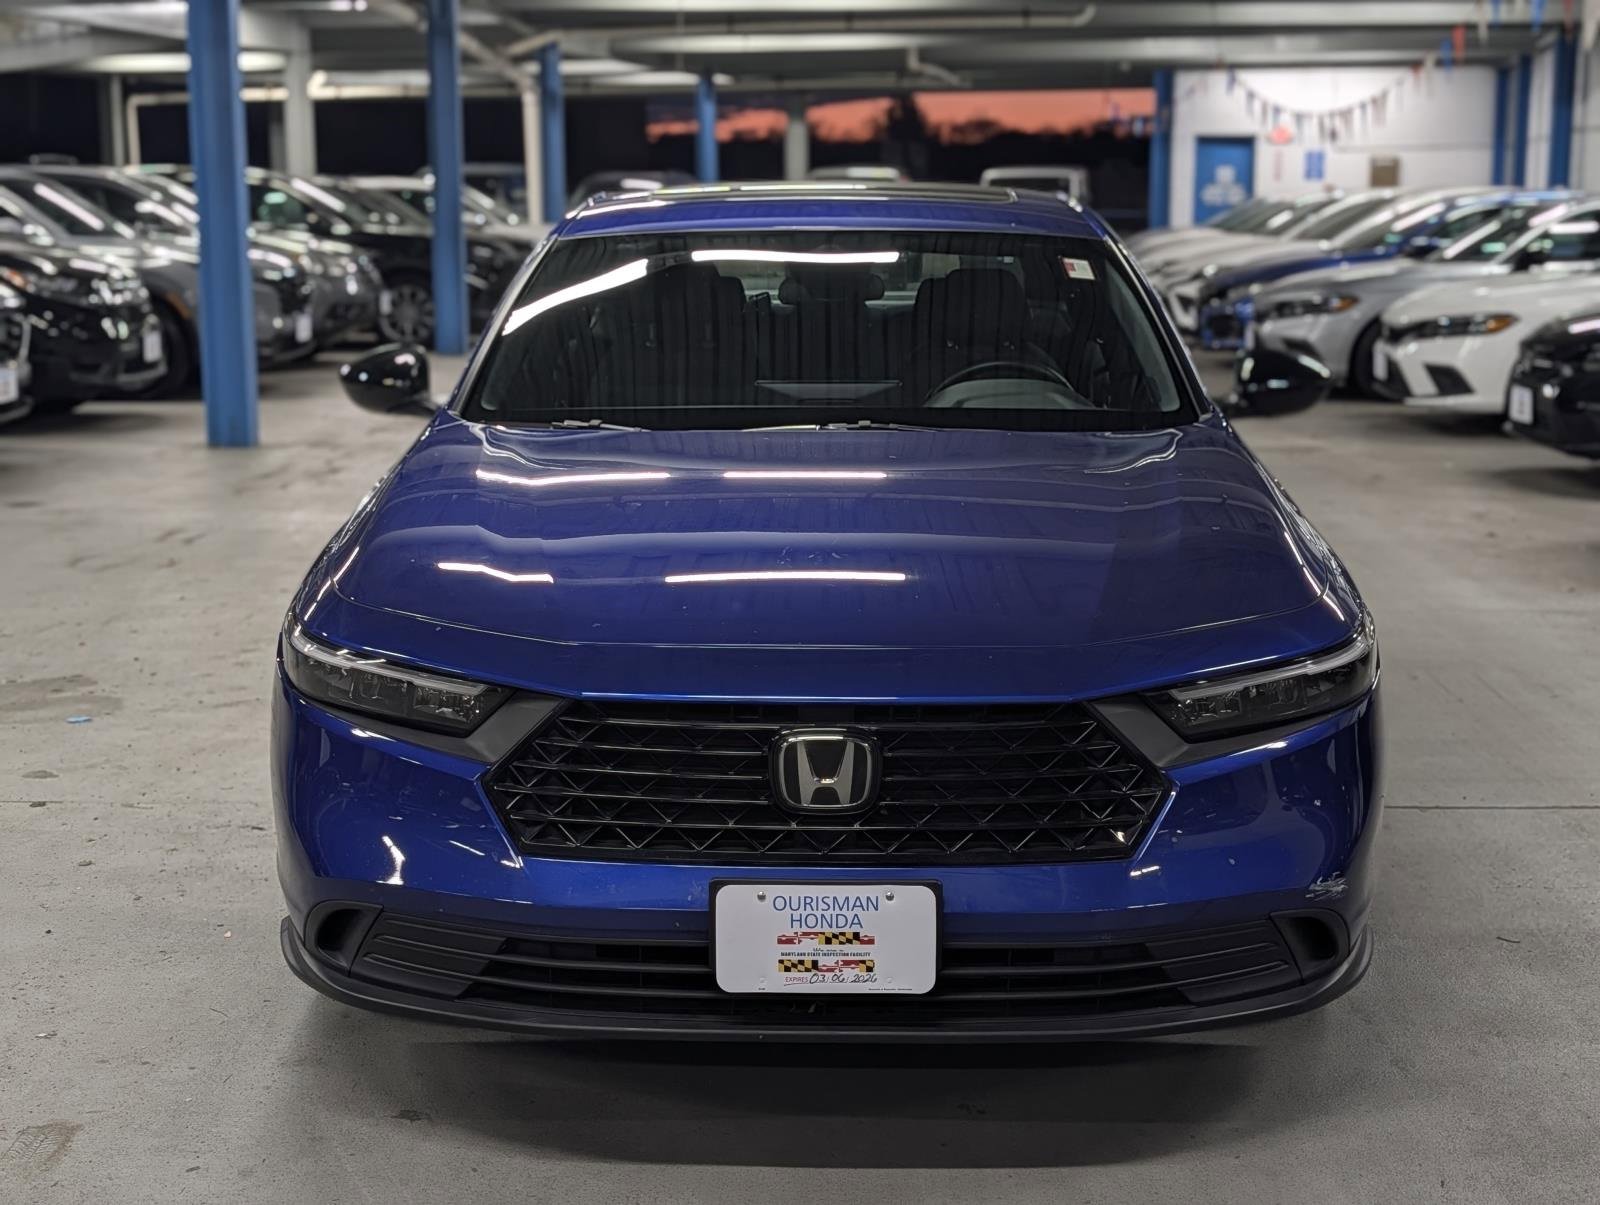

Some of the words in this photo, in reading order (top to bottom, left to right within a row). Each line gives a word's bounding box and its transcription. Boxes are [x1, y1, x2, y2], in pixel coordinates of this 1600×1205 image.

[773, 895, 879, 911] OURISMAN
[790, 913, 863, 929] HONDA
[785, 976, 808, 984] EXPIRES
